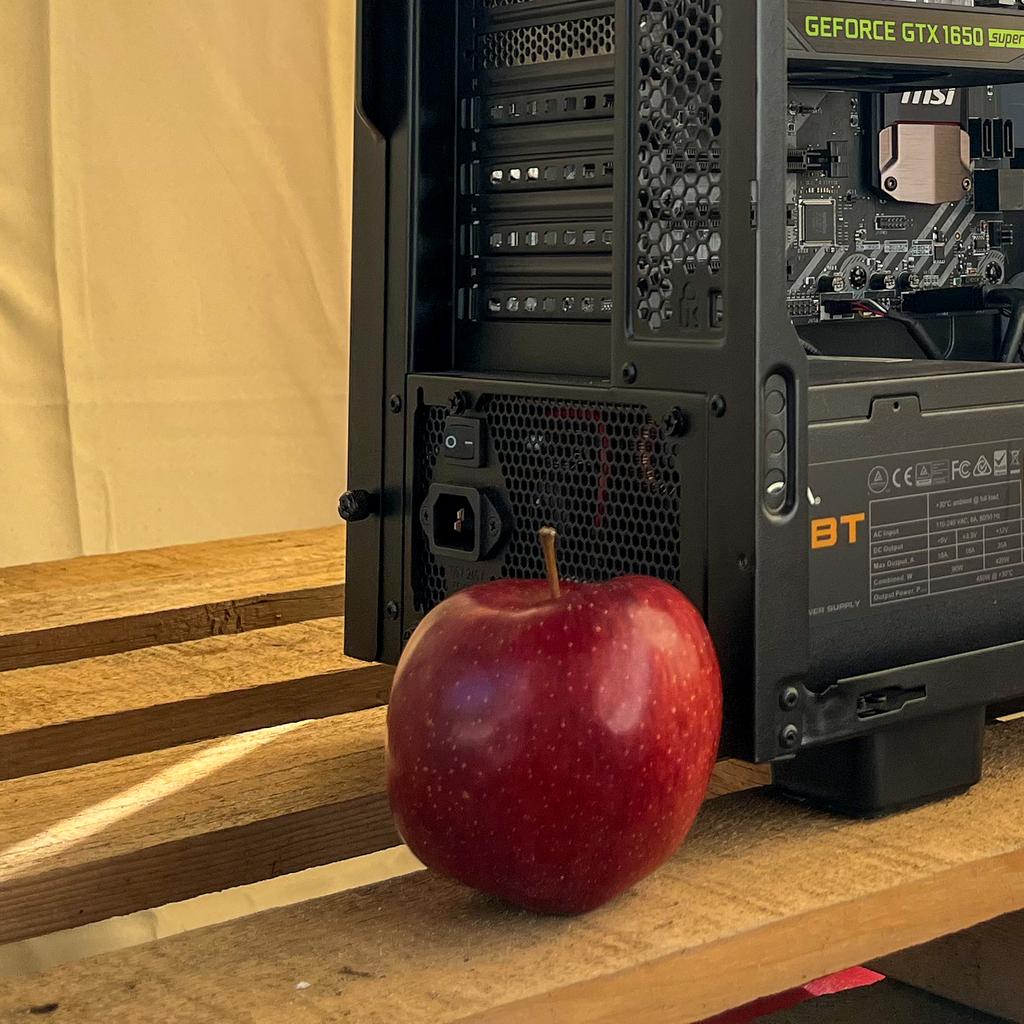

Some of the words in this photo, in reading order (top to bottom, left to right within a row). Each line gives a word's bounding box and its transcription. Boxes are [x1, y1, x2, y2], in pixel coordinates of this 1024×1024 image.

[804, 15, 896, 42] GEFORCE
[901, 22, 939, 44] GTX
[943, 25, 984, 47] 1650
[811, 512, 865, 550] BT
[827, 600, 861, 613] SUPPLY
